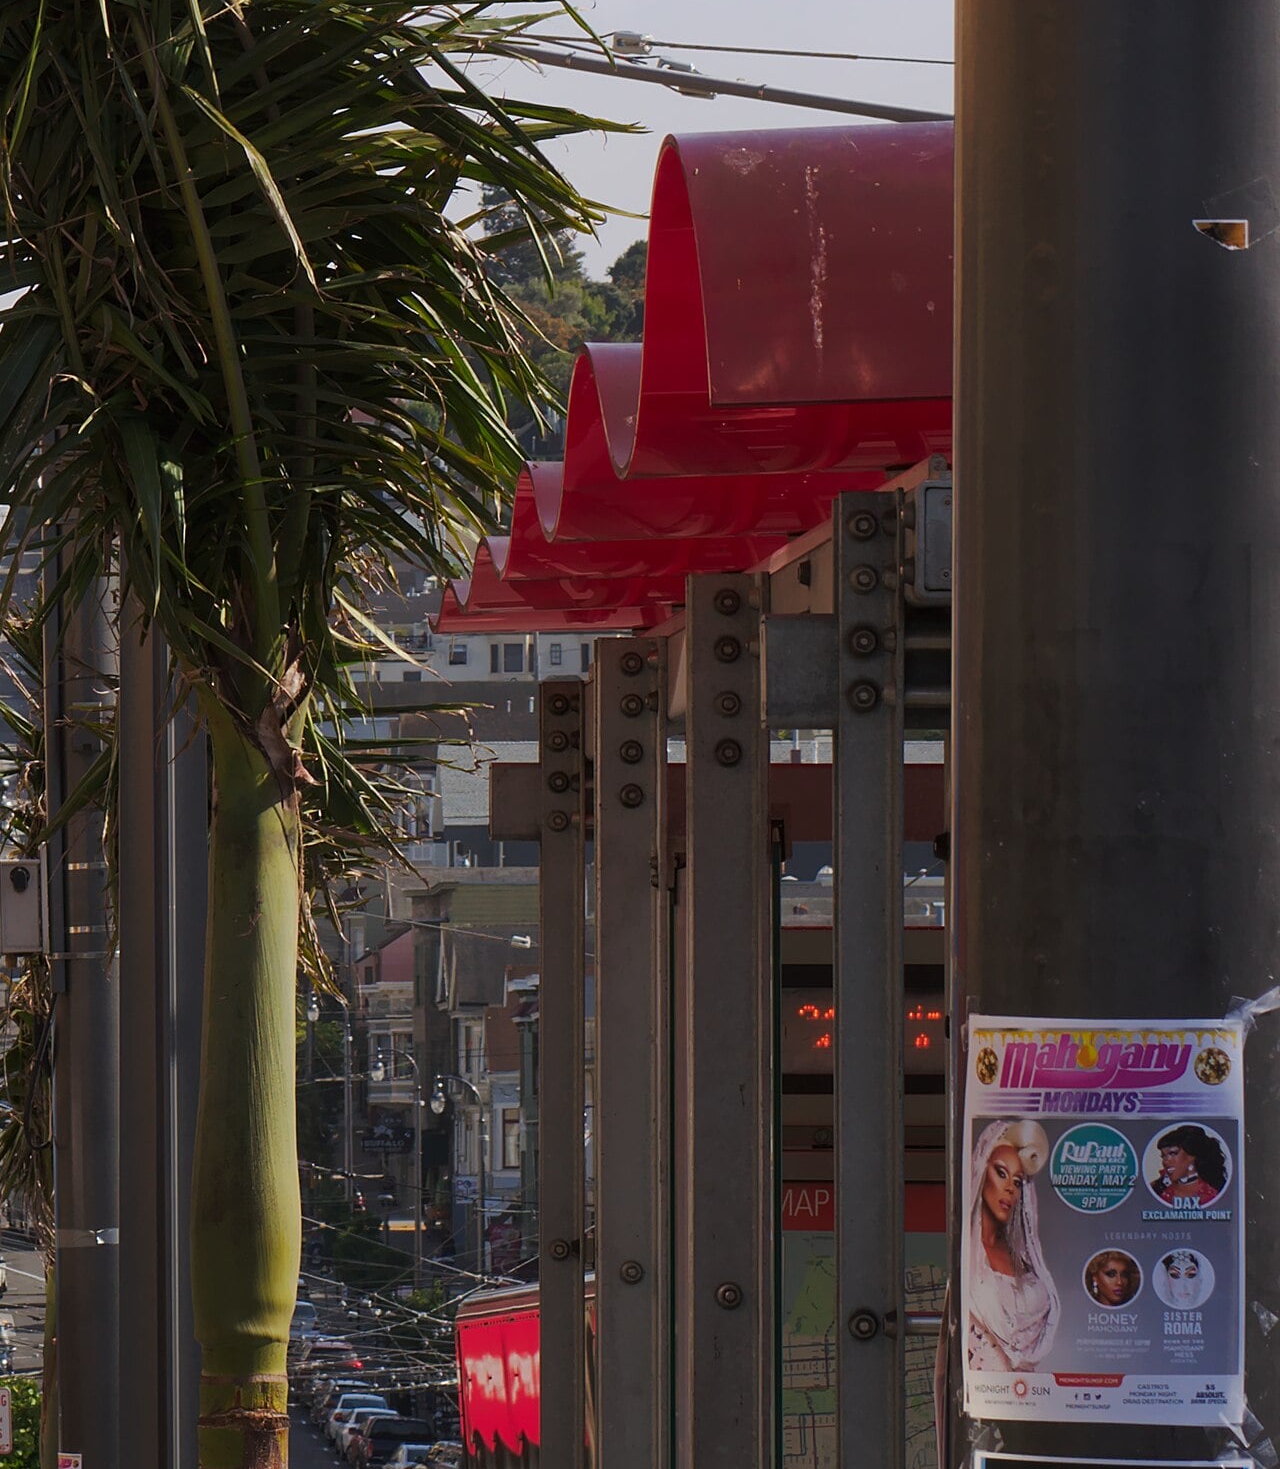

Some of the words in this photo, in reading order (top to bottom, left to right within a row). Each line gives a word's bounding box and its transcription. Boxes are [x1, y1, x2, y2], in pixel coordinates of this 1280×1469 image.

[1041, 1091, 1140, 1114] MONDAYS
[1060, 1164, 1097, 1175] VIEWING
[1099, 1164, 1129, 1175] PARTY
[1052, 1173, 1098, 1188] MONDAY,
[1102, 1173, 1127, 1186] MAY
[1127, 1173, 1138, 1186] 2
[1080, 1196, 1108, 1209] 9PM
[1173, 1197, 1202, 1211] DAX
[1142, 1210, 1202, 1222] EXCLAMATION
[1204, 1209, 1233, 1221] POINT
[1087, 1312, 1139, 1325] HONEY
[1163, 1311, 1203, 1322] SISTER
[1087, 1325, 1139, 1334] MAHOGANY
[1163, 1321, 1203, 1335] ROMA
[974, 1382, 1011, 1396] MIDNIGHT
[1031, 1386, 1052, 1396] SUN
